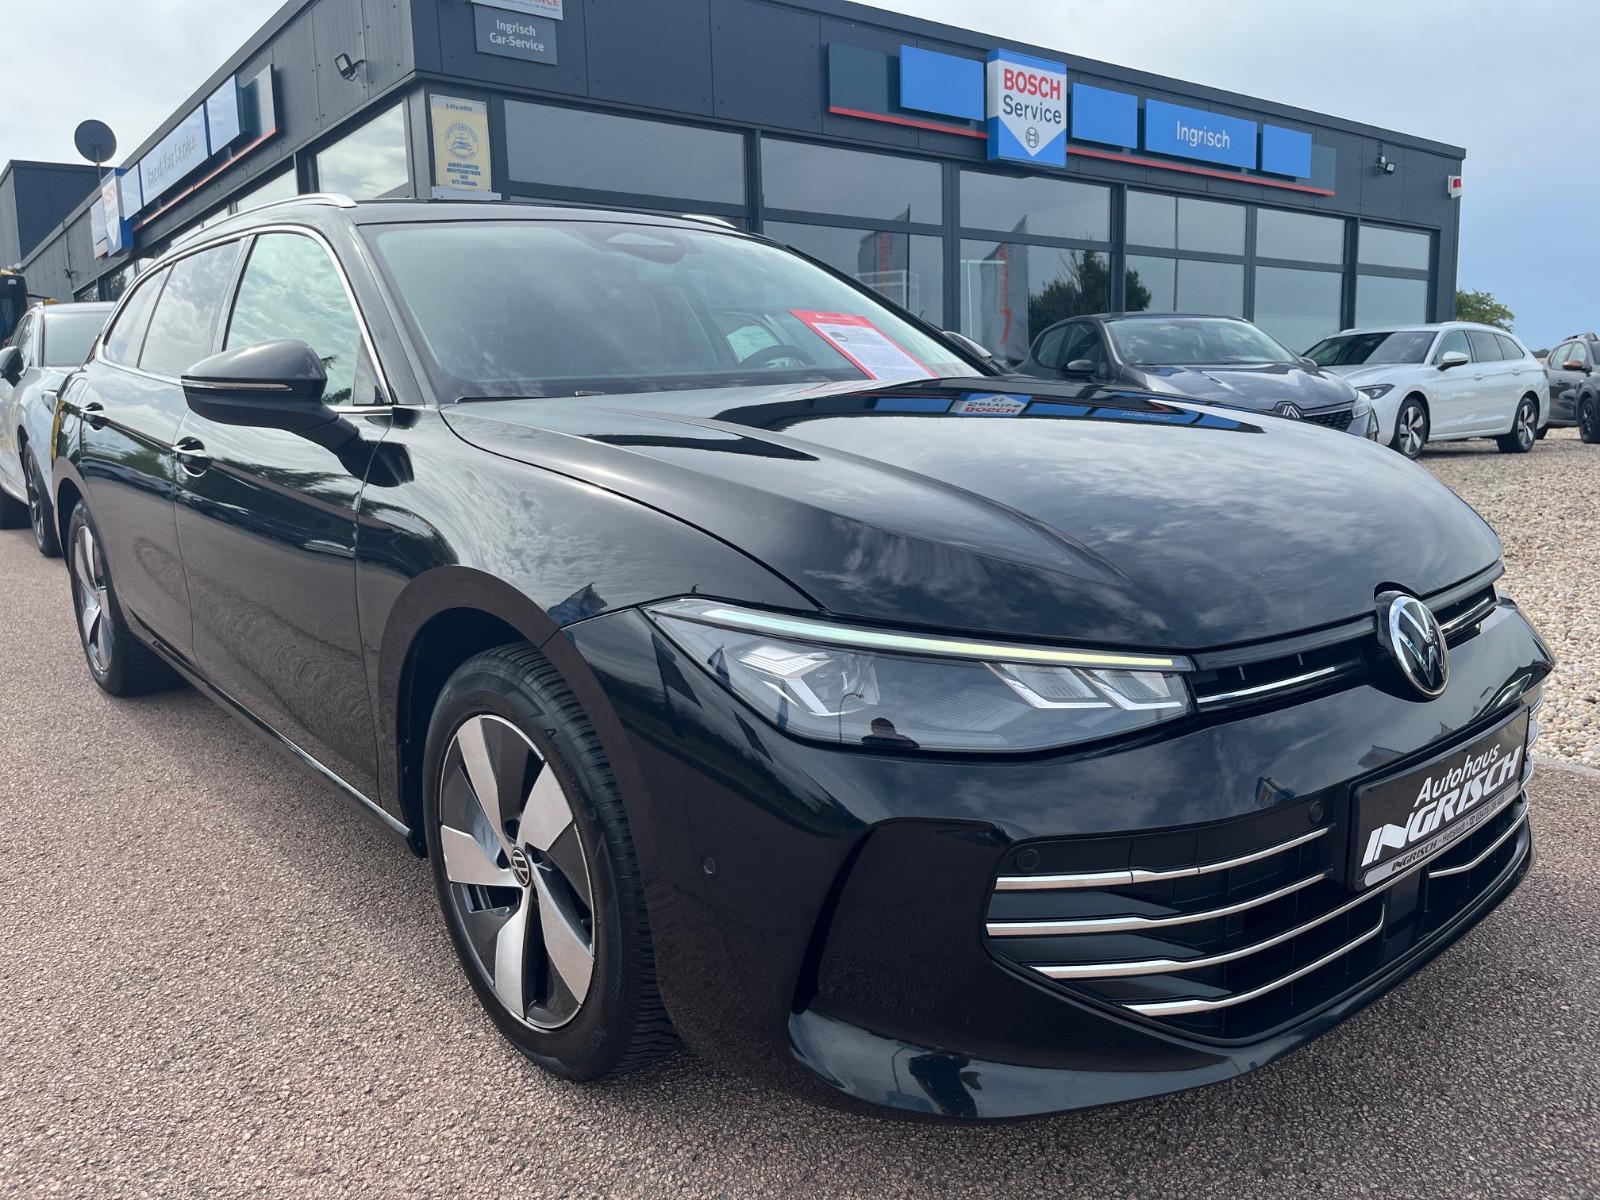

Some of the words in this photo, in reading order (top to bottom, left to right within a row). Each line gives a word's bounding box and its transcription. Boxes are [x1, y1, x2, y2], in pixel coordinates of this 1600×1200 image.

[489, 32, 545, 52] Car-Service
[496, 19, 536, 37] Ingrisch
[1003, 67, 1061, 101] BOSCH
[1002, 94, 1062, 125] Service
[1176, 120, 1230, 150] Ingrisch
[1413, 743, 1501, 807] Autohaus
[1361, 745, 1522, 867] INGRISCH
[1391, 840, 1437, 872] INGRISCH
